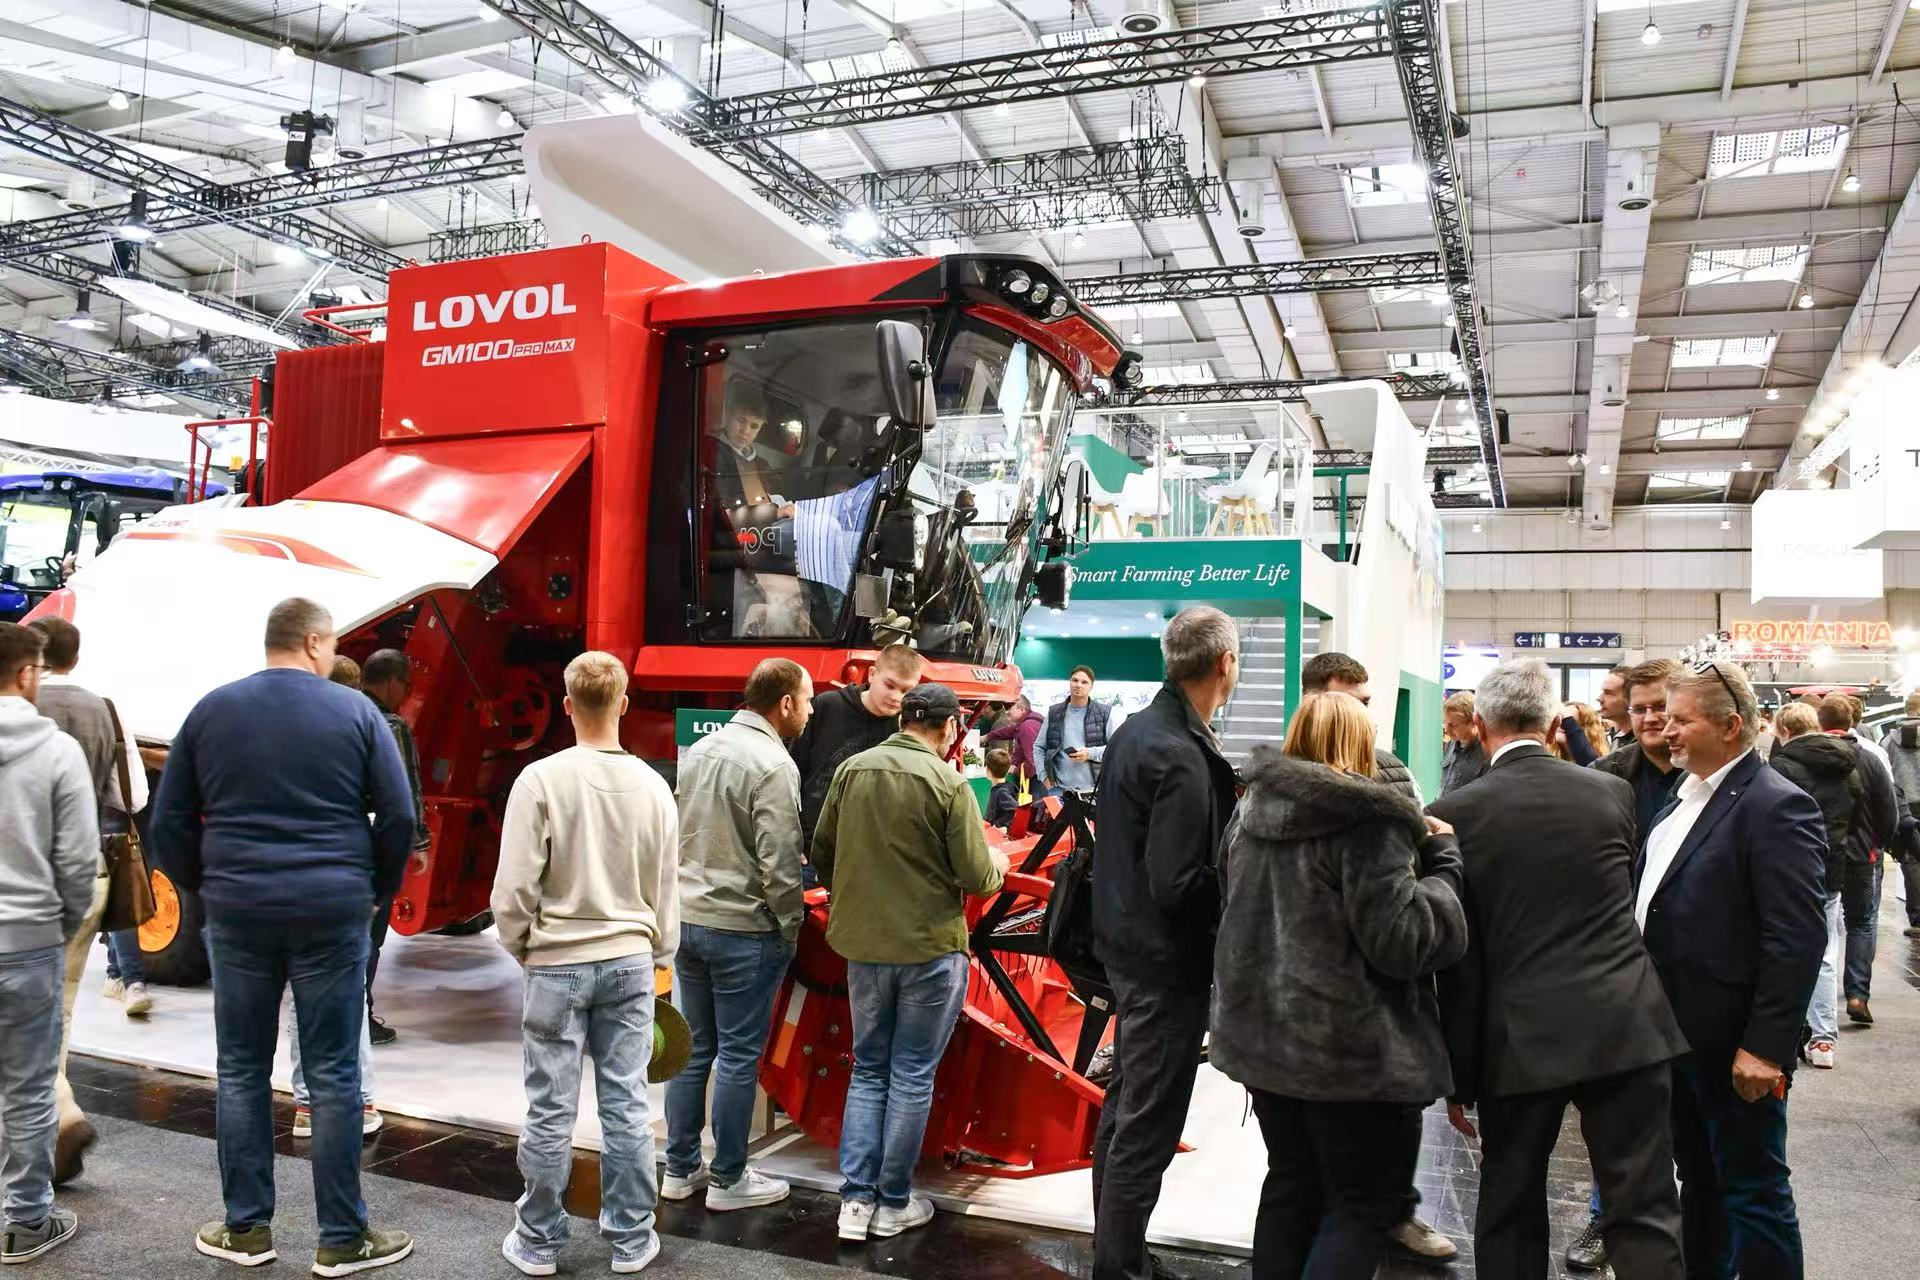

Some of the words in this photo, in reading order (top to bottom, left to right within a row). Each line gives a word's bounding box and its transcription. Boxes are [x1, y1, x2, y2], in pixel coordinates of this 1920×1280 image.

[413, 283, 576, 331] LOVOL
[422, 339, 513, 367] GM100
[513, 343, 543, 357] PRO
[545, 339, 575, 354] MAX
[1070, 566, 1117, 583] Smart
[1121, 565, 1195, 587] Farming
[1198, 564, 1250, 582] Better
[1253, 563, 1290, 586] Life
[1564, 636, 1571, 646] 8
[1730, 620, 1894, 645] ROMANIA
[693, 721, 731, 734] LOV
